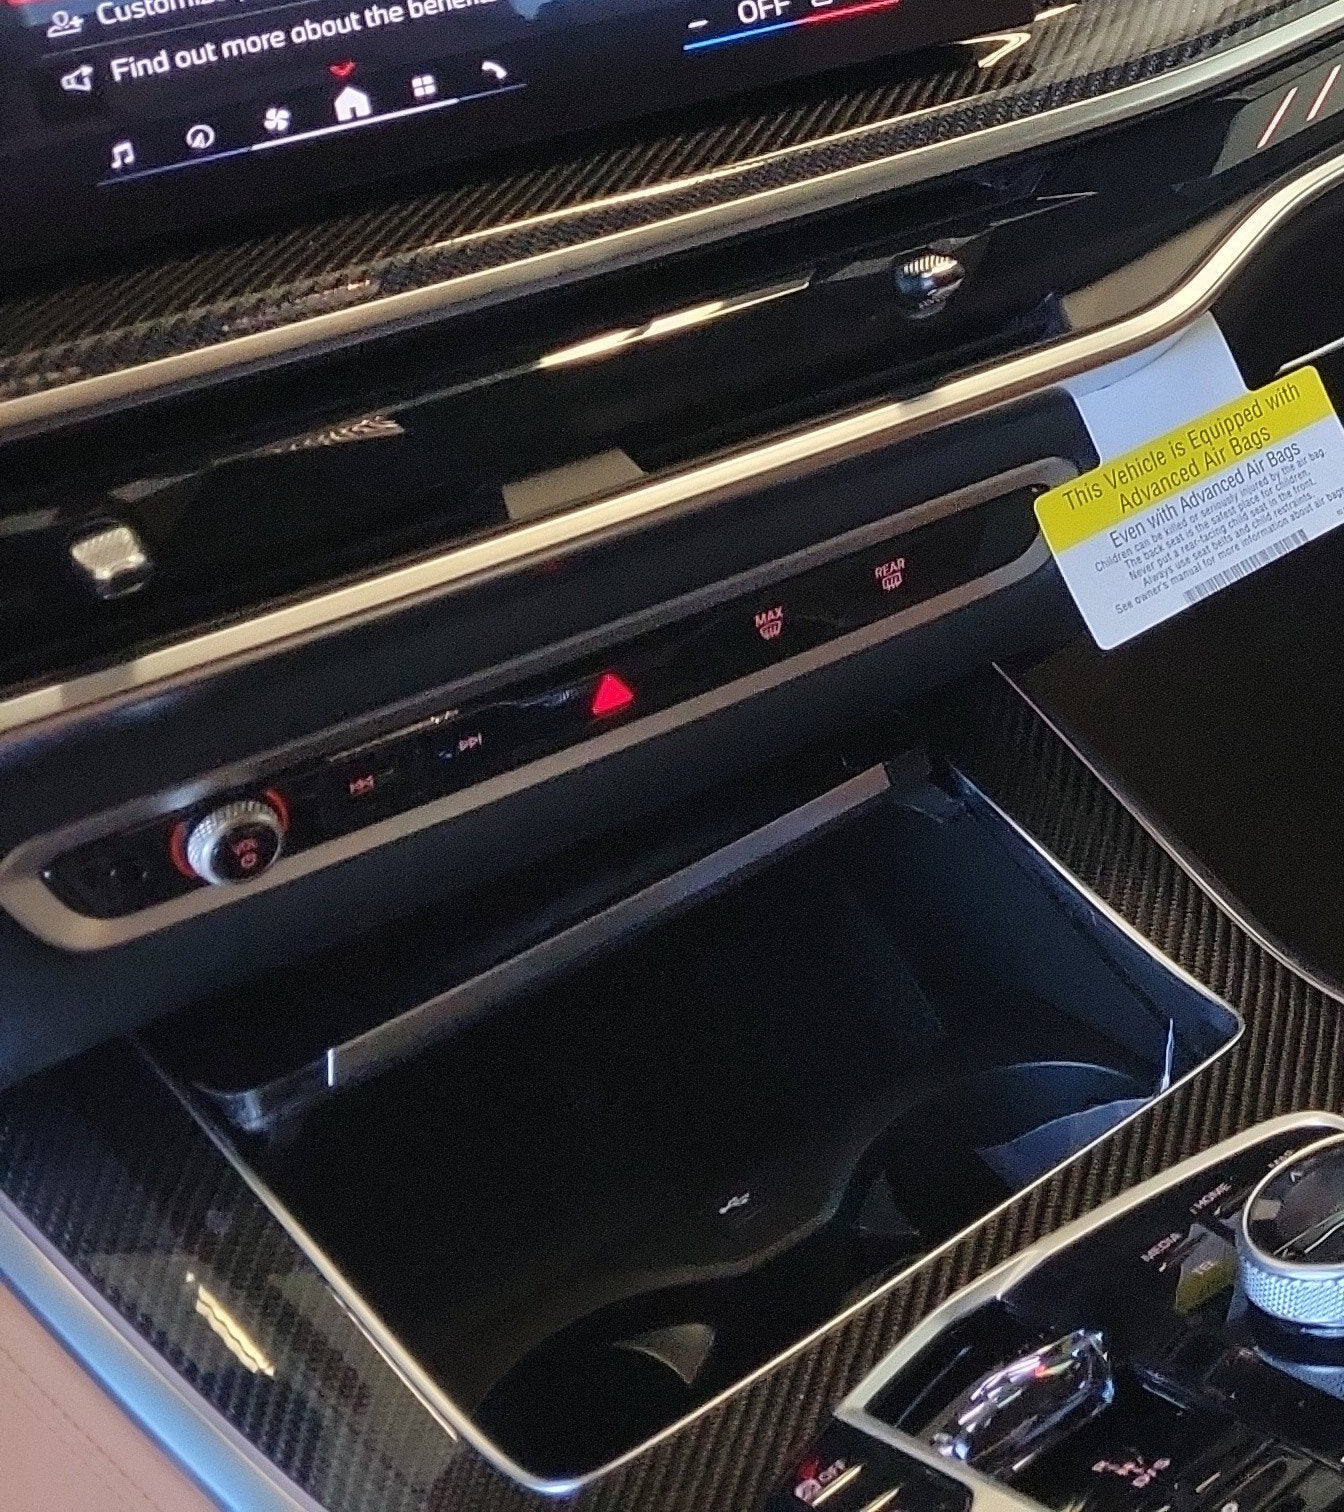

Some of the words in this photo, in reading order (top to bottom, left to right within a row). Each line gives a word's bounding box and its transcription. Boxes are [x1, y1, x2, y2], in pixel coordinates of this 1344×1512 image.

[111, 49, 171, 83] Find
[175, 42, 218, 68] out
[222, 30, 286, 59] more
[291, 12, 362, 45] about
[365, 5, 405, 29] the
[1061, 481, 1103, 510] This
[1102, 450, 1167, 489] Vehicle
[1167, 440, 1186, 459] is
[1187, 398, 1263, 449] Equipped
[1263, 383, 1300, 410] with
[1119, 458, 1200, 513] Advanced
[1203, 446, 1226, 471] Air
[1228, 426, 1270, 456] Bags
[1094, 547, 1133, 572] Children
[1133, 538, 1150, 552] can
[1150, 531, 1163, 543] be
[1162, 516, 1188, 536] killed
[1188, 512, 1198, 523] or
[1199, 492, 1238, 517] seriously
[1239, 475, 1269, 497] injured
[1268, 471, 1280, 481] by
[1280, 463, 1295, 475] the
[1295, 455, 1307, 468] air
[1108, 521, 1146, 548] Even
[1145, 503, 1178, 528] with
[1179, 467, 1244, 513] Advanced
[1246, 458, 1265, 479] Air
[1265, 442, 1300, 467] Bags
[1123, 555, 1142, 569] The
[1142, 543, 1165, 560] back
[1164, 532, 1185, 549] seat
[1184, 528, 1194, 538] is
[1194, 520, 1210, 533] the
[1210, 505, 1237, 525] safest
[1236, 494, 1260, 513] place
[1259, 486, 1273, 499] for
[1274, 469, 1311, 491] children.
[1128, 561, 1154, 580] Never
[1156, 551, 1173, 568] put
[1227, 511, 1249, 529] child
[1249, 501, 1268, 517] seat
[1267, 497, 1278, 507] in
[1277, 489, 1292, 502] the
[874, 557, 906, 579] REAR
[1114, 600, 1133, 614] See
[1134, 581, 1169, 604] owner's
[1169, 561, 1202, 585] manual
[1201, 555, 1215, 567] for
[1217, 543, 1240, 559] more
[1240, 517, 1289, 547] information
[1289, 502, 1314, 521] about
[1313, 496, 1325, 508] air
[1142, 564, 1174, 587] Always
[1174, 556, 1191, 569] use
[1191, 544, 1211, 560] seat
[1234, 522, 1251, 538] and
[1251, 511, 1272, 529] child
[755, 605, 784, 628] MAX
[1189, 1182, 1233, 1215] HOME
[1140, 1232, 1183, 1263] MEDIA
